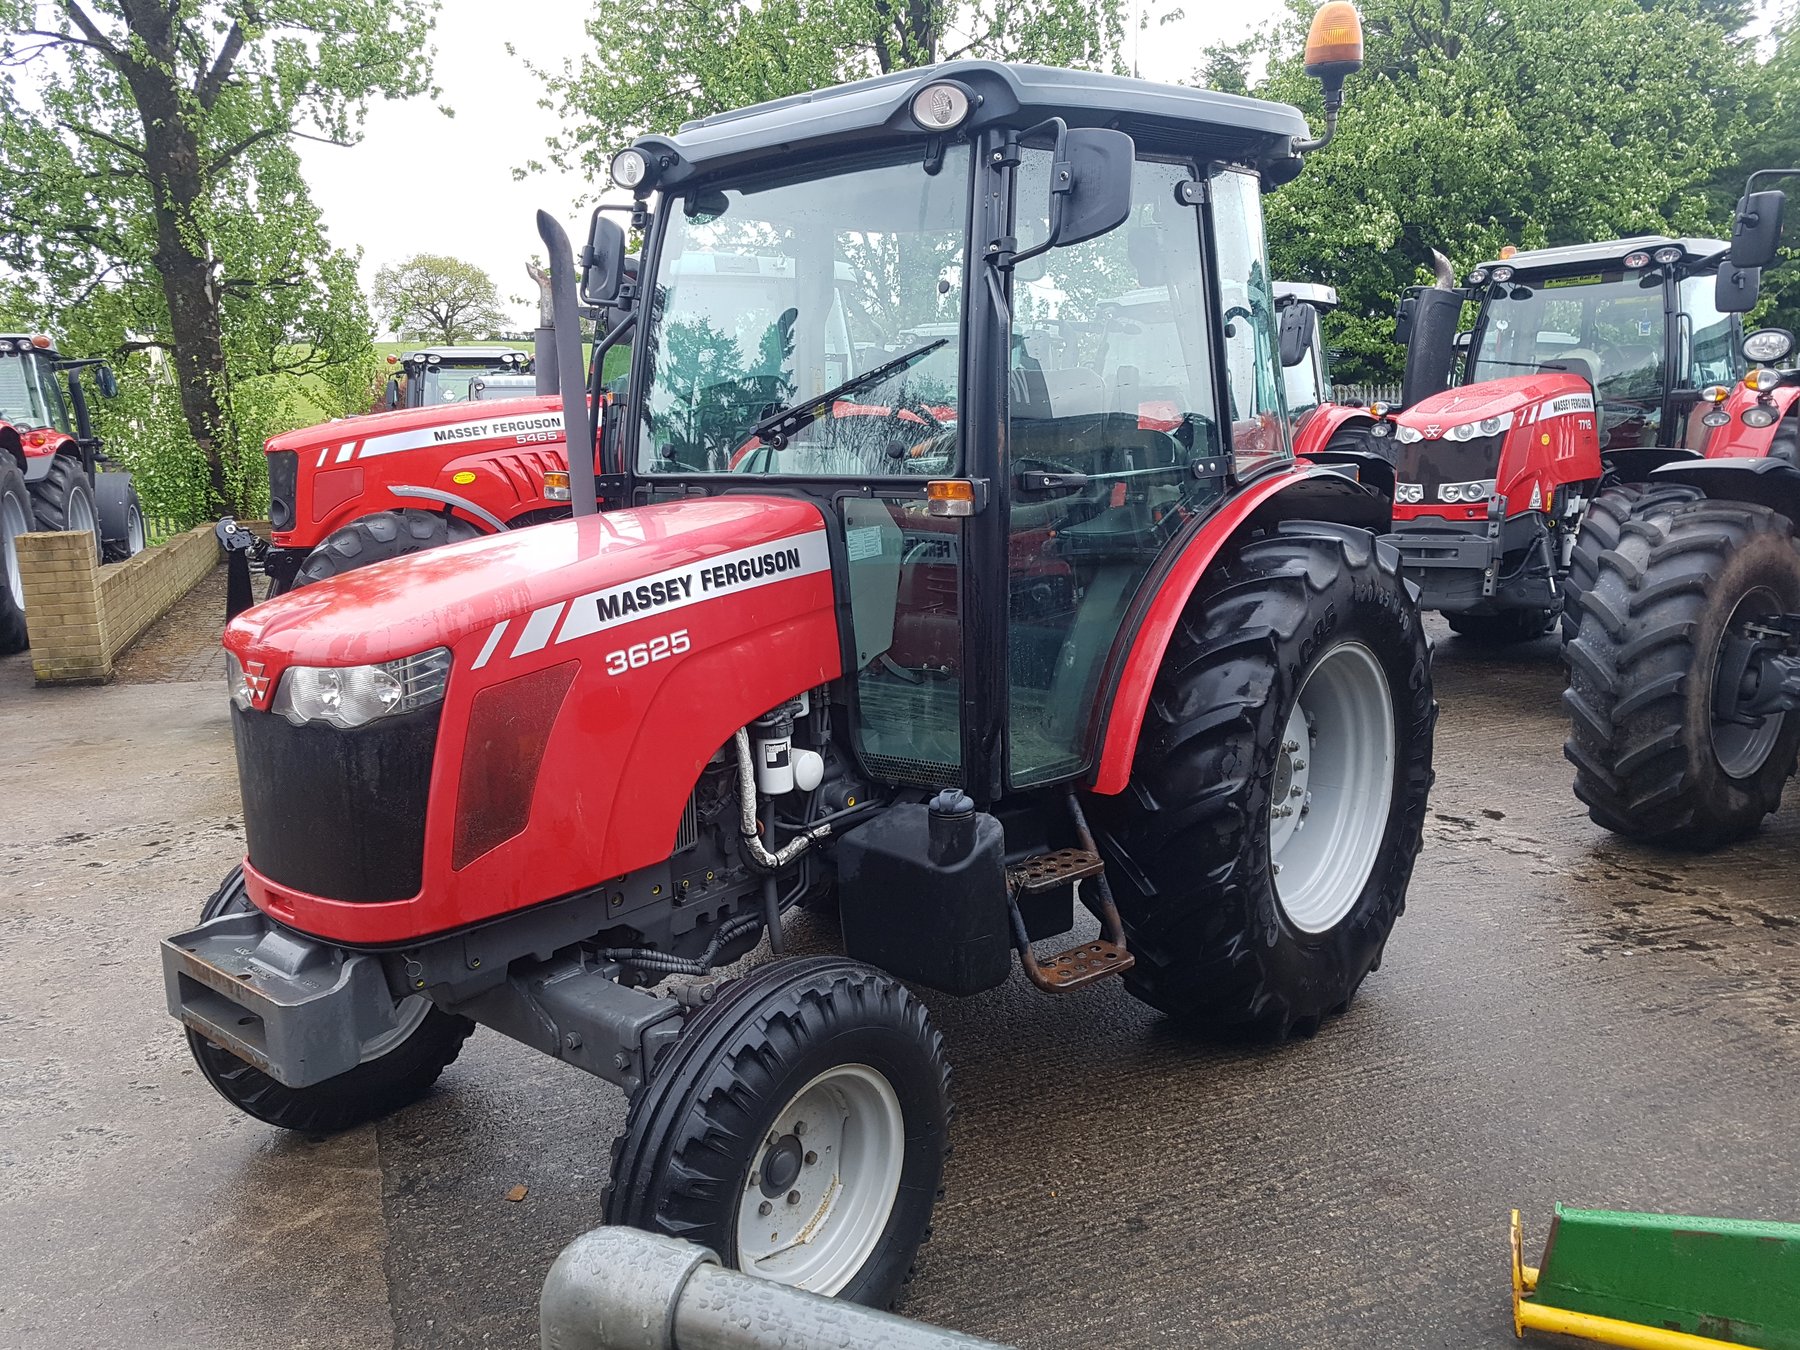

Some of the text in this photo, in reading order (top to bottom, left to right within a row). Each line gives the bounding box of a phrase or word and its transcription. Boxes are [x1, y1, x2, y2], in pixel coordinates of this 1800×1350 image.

[1553, 399, 1571, 413] MASSEY
[433, 417, 561, 442] MASSEY FERGUSON
[516, 431, 558, 444] 5465
[595, 548, 801, 622] MASSEY FERGUSON
[605, 629, 691, 676] 3625
